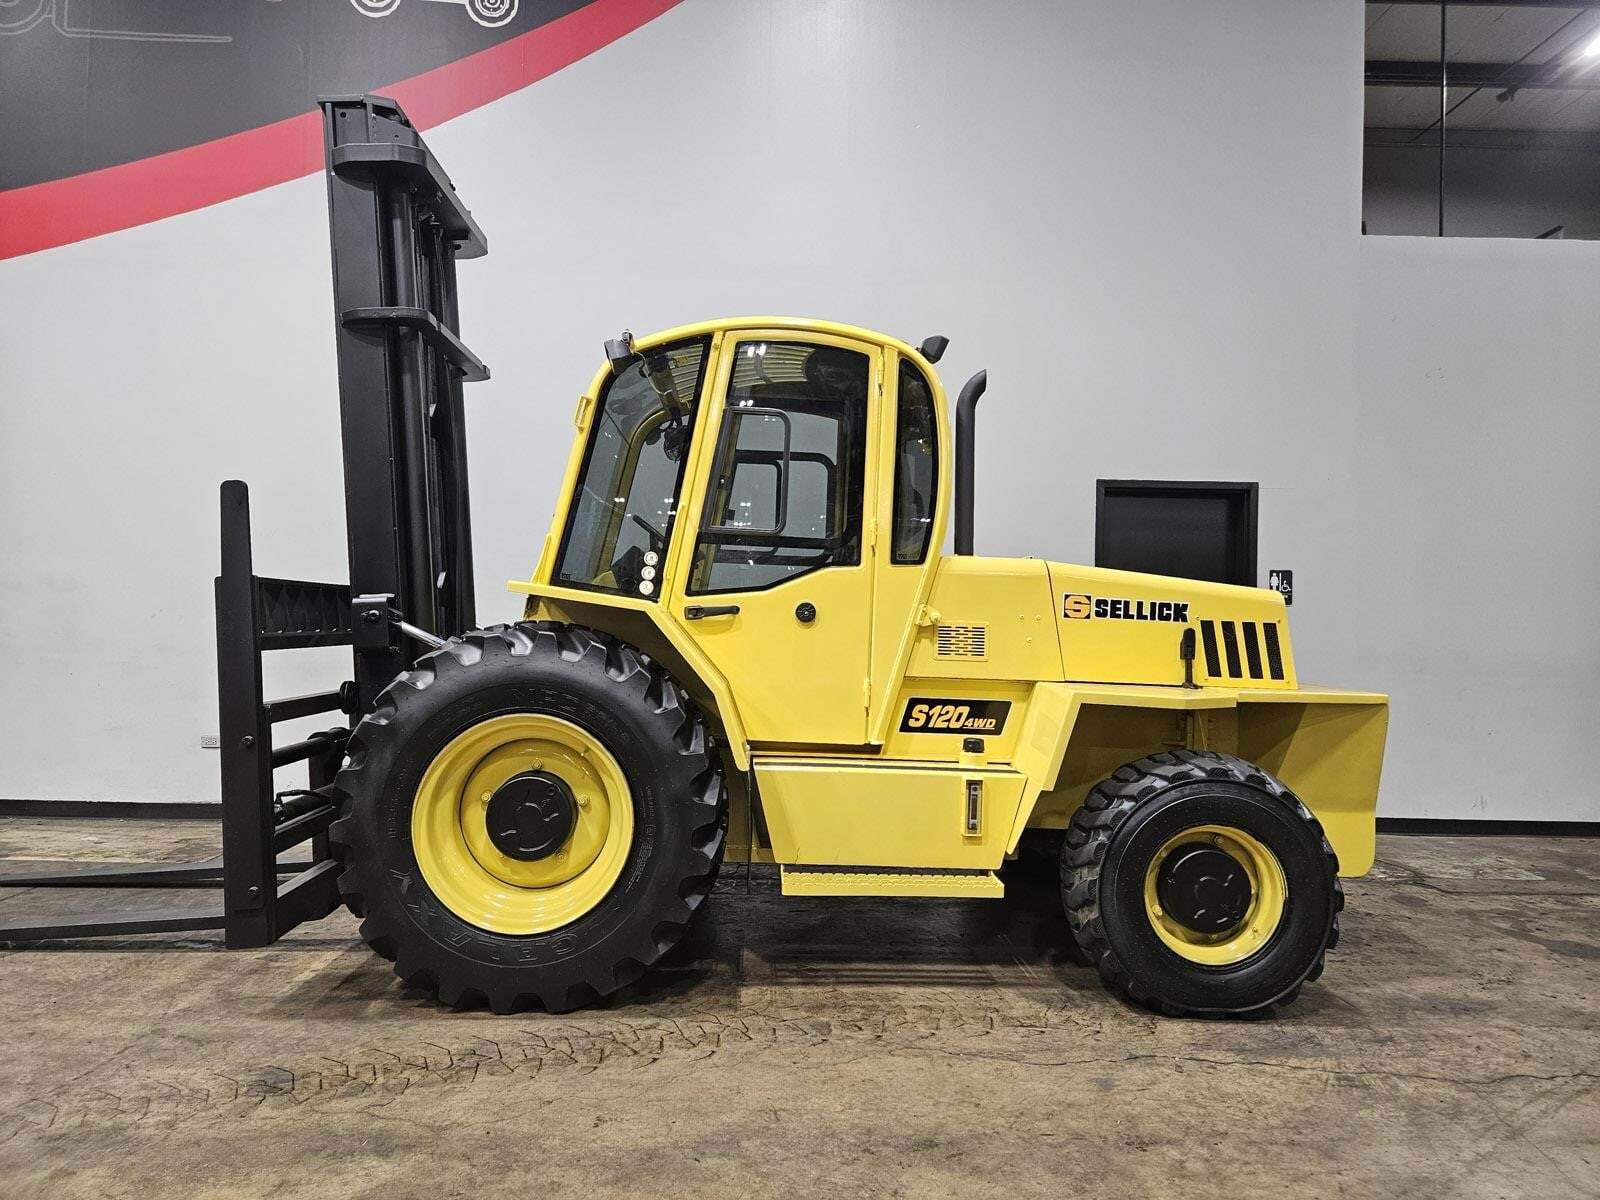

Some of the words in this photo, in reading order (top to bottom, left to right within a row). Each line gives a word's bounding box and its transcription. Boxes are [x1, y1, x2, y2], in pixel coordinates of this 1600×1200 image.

[1064, 594, 1091, 618] S
[1095, 599, 1189, 622] SELLICK
[908, 704, 970, 729] S120
[963, 718, 997, 730] 4WD
